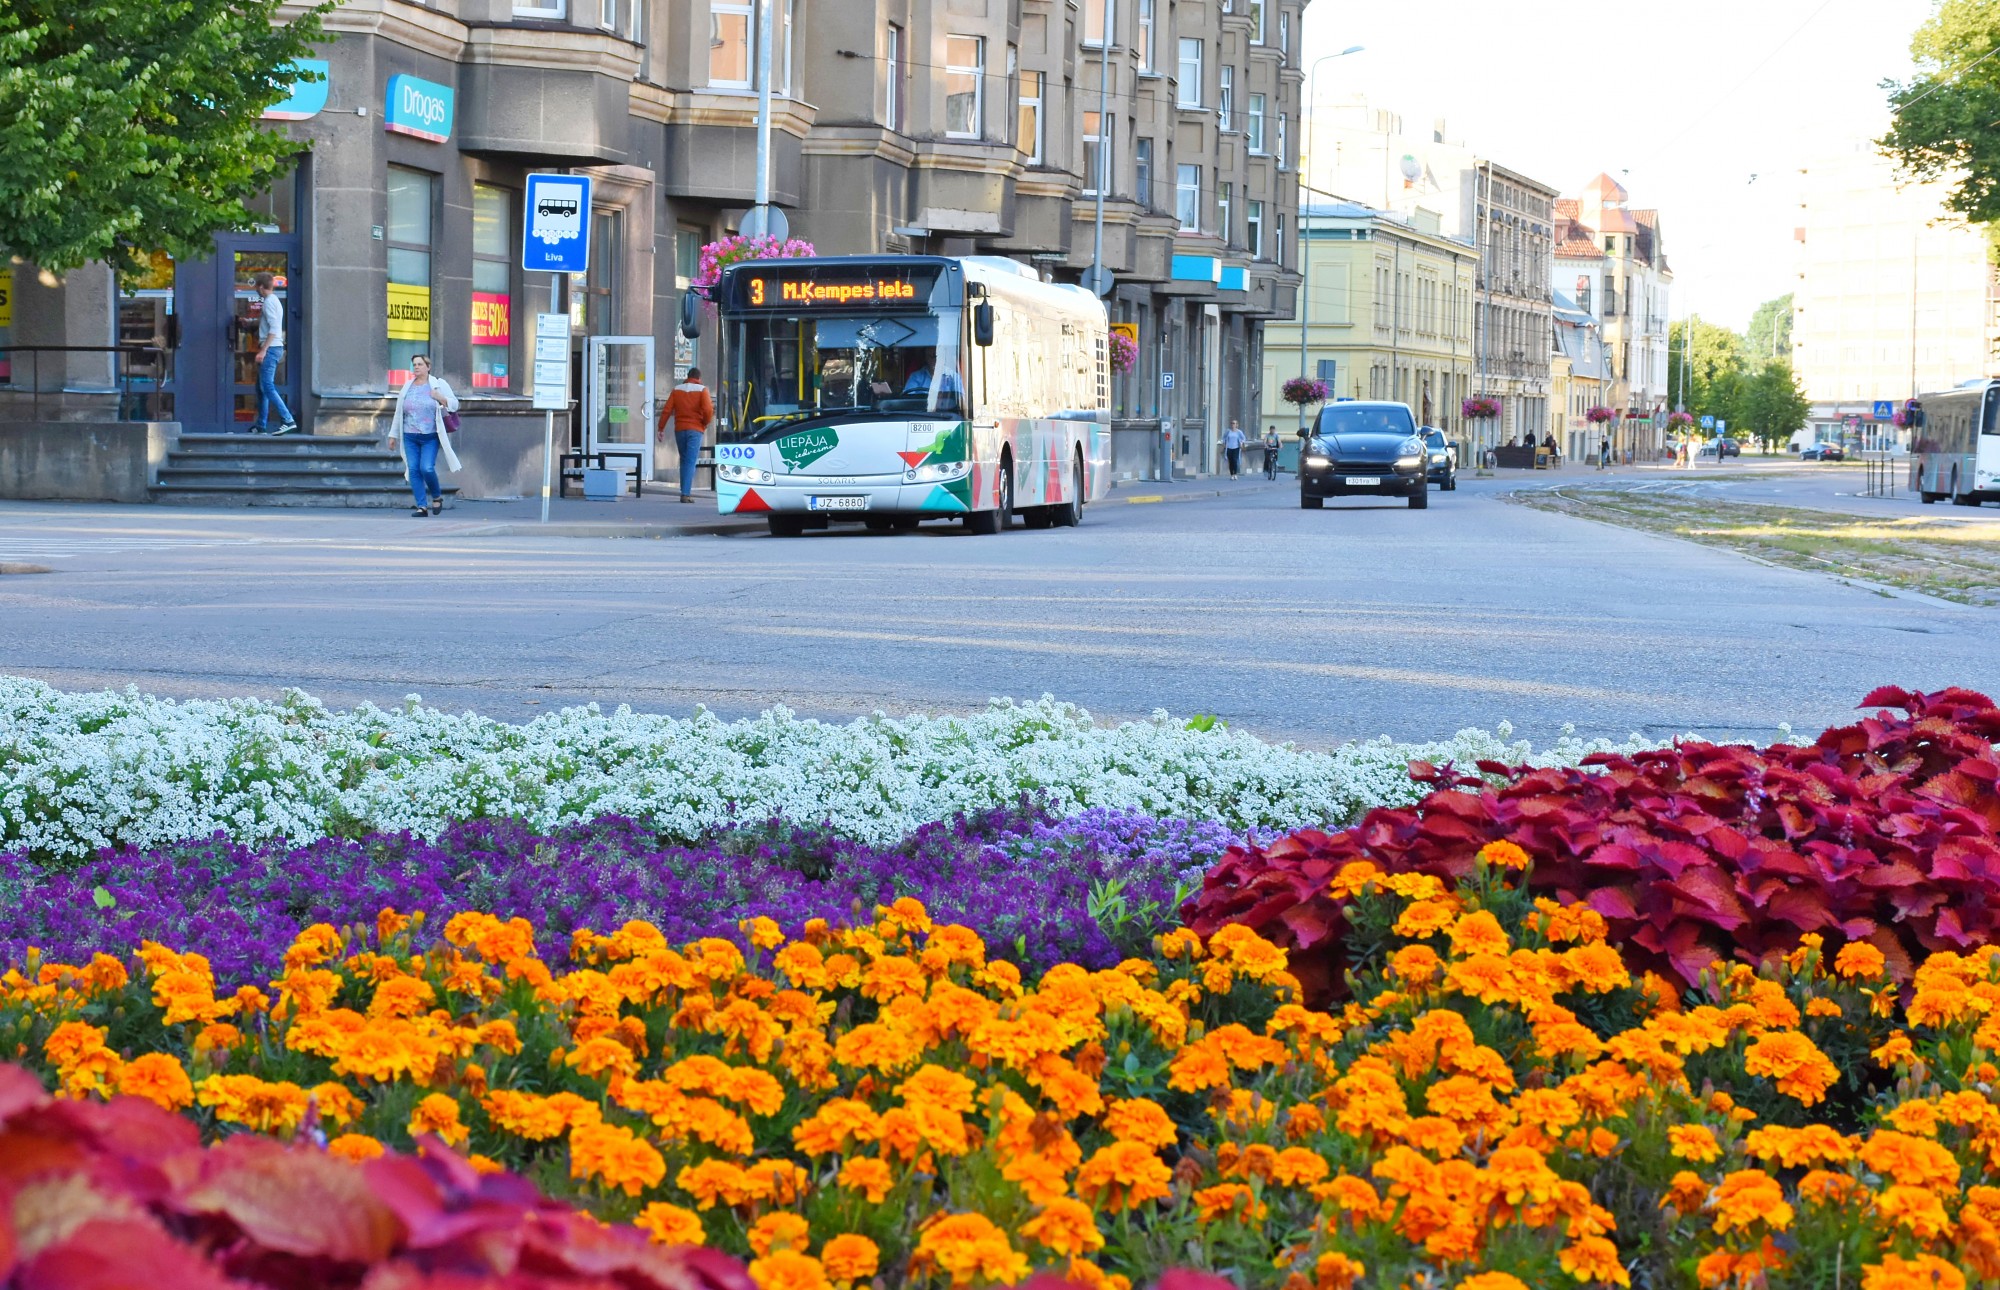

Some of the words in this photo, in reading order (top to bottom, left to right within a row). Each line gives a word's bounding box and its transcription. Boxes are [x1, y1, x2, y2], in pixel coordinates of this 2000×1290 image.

[404, 85, 445, 125] Drogas
[751, 279, 763, 304] 3
[878, 281, 914, 298] iela
[488, 302, 508, 337] 50%
[1164, 375, 1172, 386] P
[913, 423, 932, 432] 8200
[779, 434, 828, 449] LIEPĀJA
[794, 444, 836, 459] iedvesma
[817, 477, 857, 485] SOLARIS
